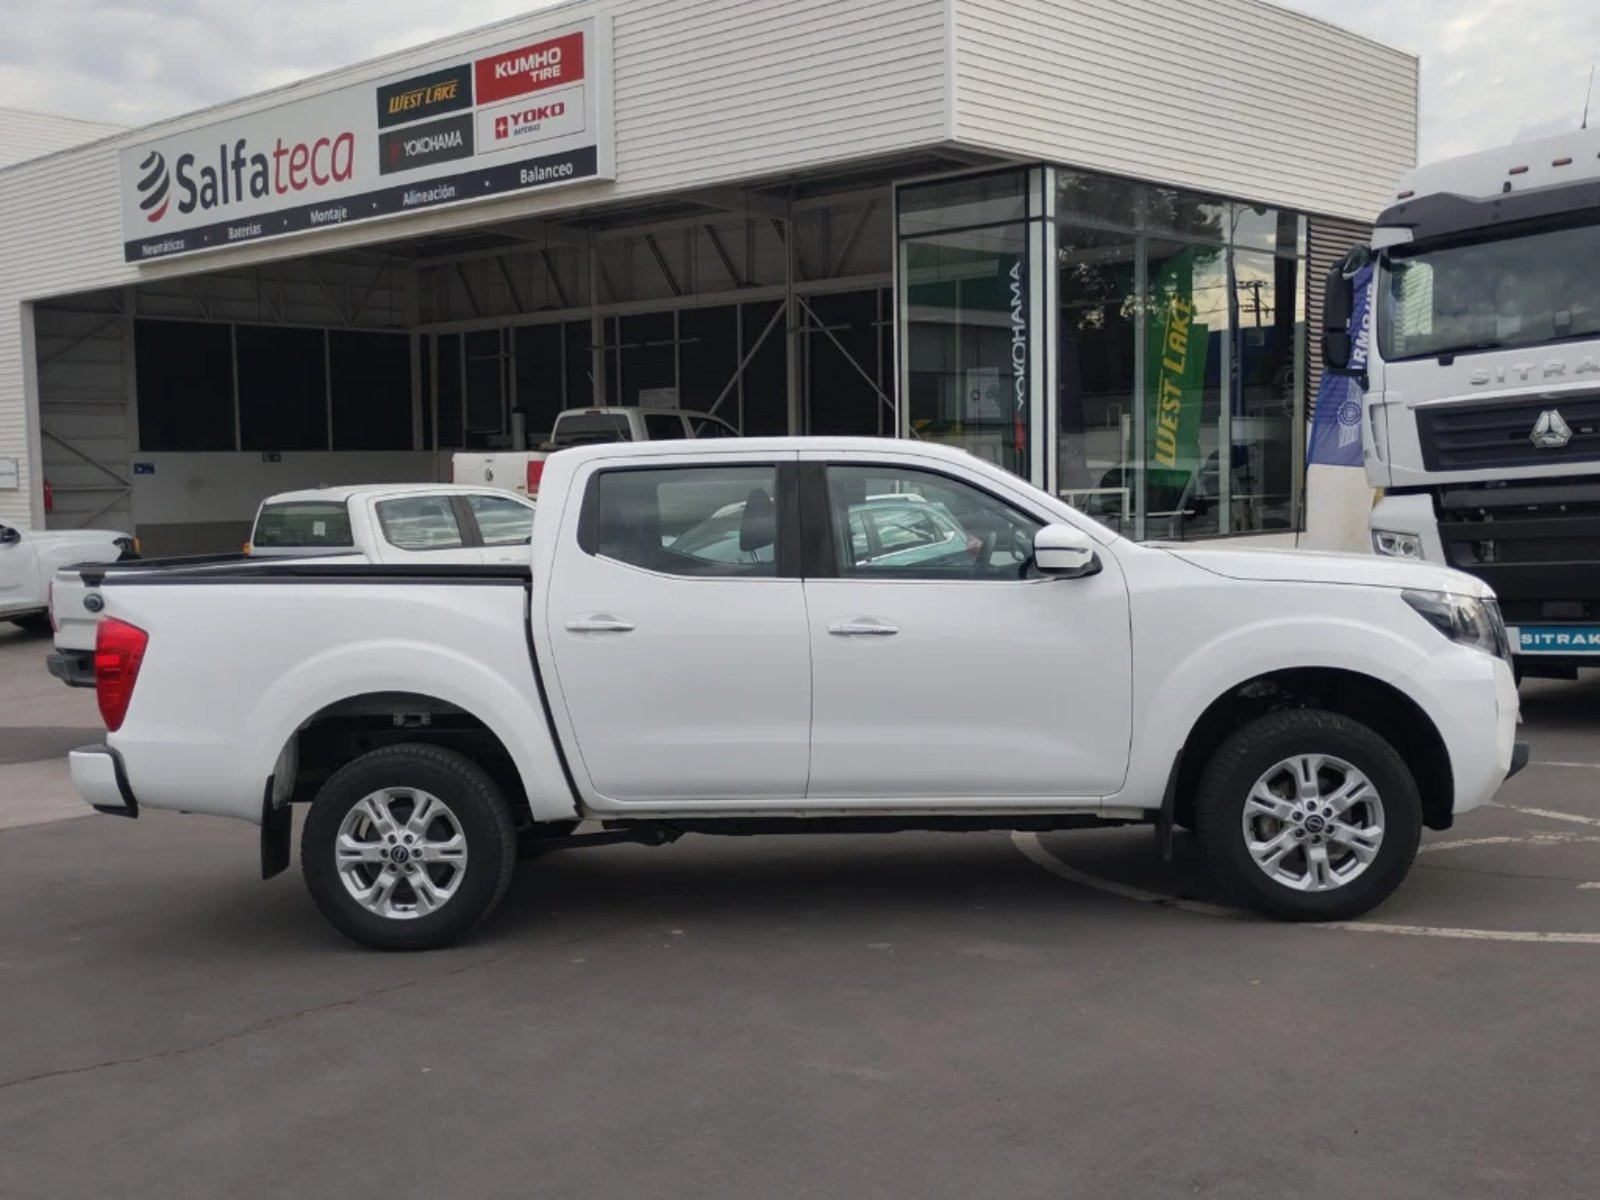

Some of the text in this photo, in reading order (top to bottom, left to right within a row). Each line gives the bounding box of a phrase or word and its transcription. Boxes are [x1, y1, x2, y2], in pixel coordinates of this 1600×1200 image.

[495, 46, 562, 79] KUMHO
[529, 64, 562, 83] TIRE
[388, 79, 459, 114] WEST LAKE
[510, 102, 565, 126] YOKO
[403, 130, 463, 157] YOKOHAMA
[176, 132, 354, 214] Salfateca
[142, 238, 185, 257] Neumáticos
[310, 206, 348, 225] Montaje
[402, 184, 456, 207] Alineación
[520, 162, 574, 184] Balanceo
[1009, 262, 1026, 412] YOKOHAMA
[1155, 295, 1192, 468] WEST LAKE
[1520, 633, 1600, 645] SITRAK
